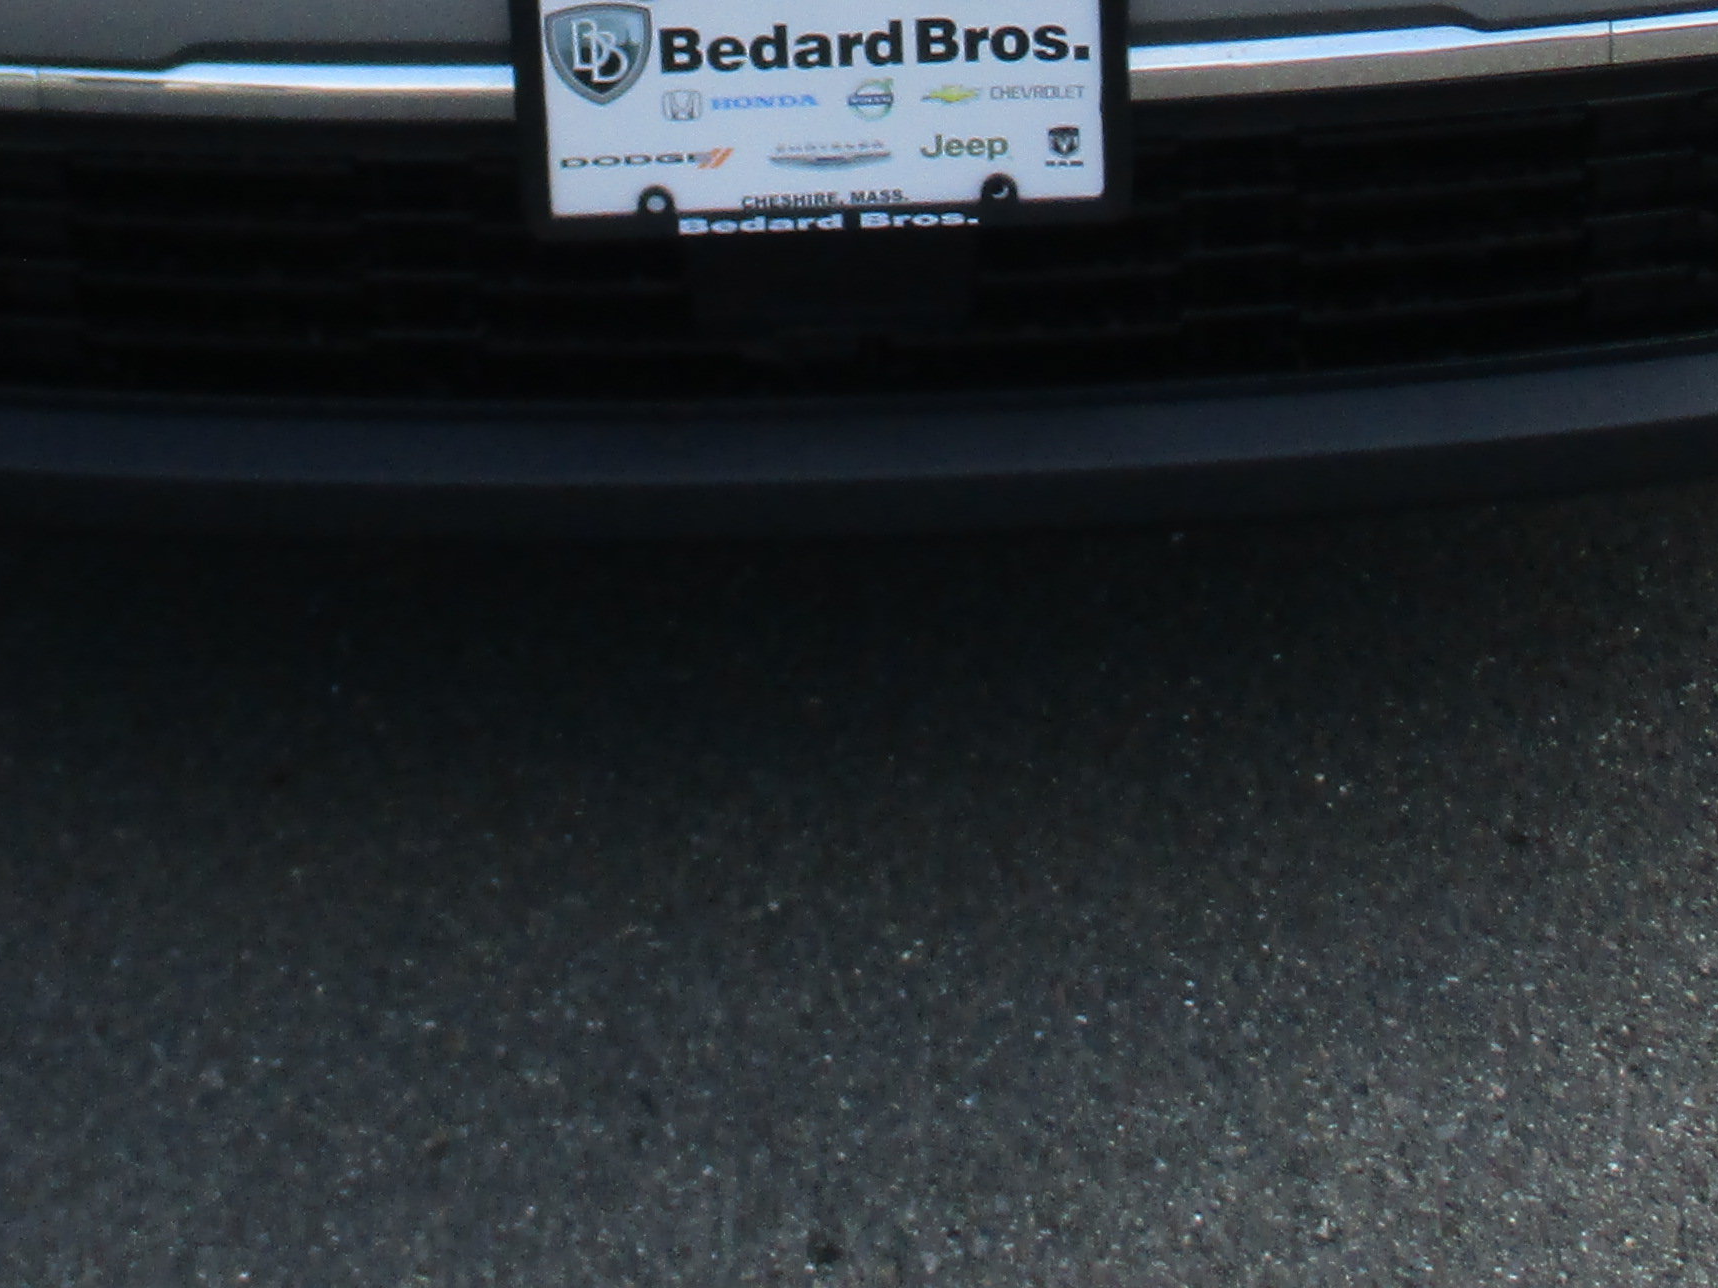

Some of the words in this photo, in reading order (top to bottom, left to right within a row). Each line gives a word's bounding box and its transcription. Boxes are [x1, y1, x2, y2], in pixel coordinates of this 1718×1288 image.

[658, 19, 904, 74] Bedard
[915, 17, 1091, 64] Bros.
[711, 93, 820, 111] HONDA
[989, 84, 1085, 101] CHEVROLET
[920, 133, 1009, 161] Jeep
[850, 188, 909, 206] MASS.
[678, 214, 844, 236] Bedard
[860, 212, 980, 229] Bros.
